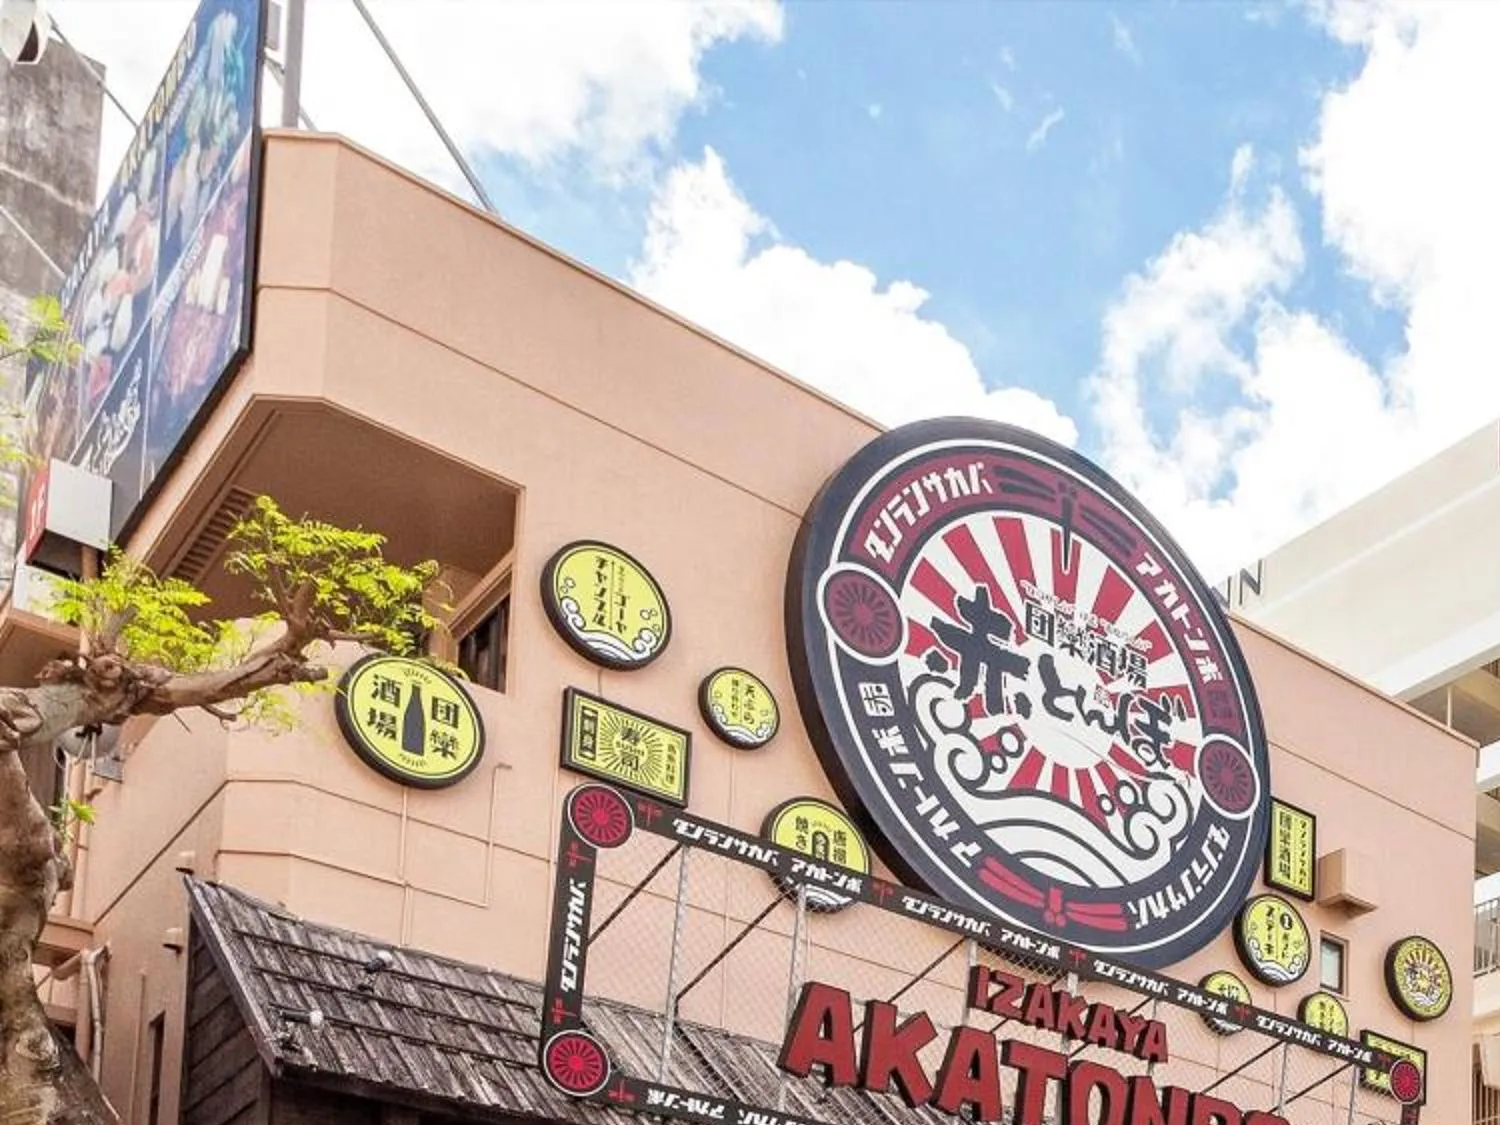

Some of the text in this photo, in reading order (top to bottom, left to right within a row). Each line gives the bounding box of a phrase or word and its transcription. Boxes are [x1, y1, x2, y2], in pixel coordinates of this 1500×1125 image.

[925, 585, 1186, 770] 赤とんぼ
[1135, 553, 1224, 684] アカトンボ
[972, 965, 1169, 1063] IZAKAYA
